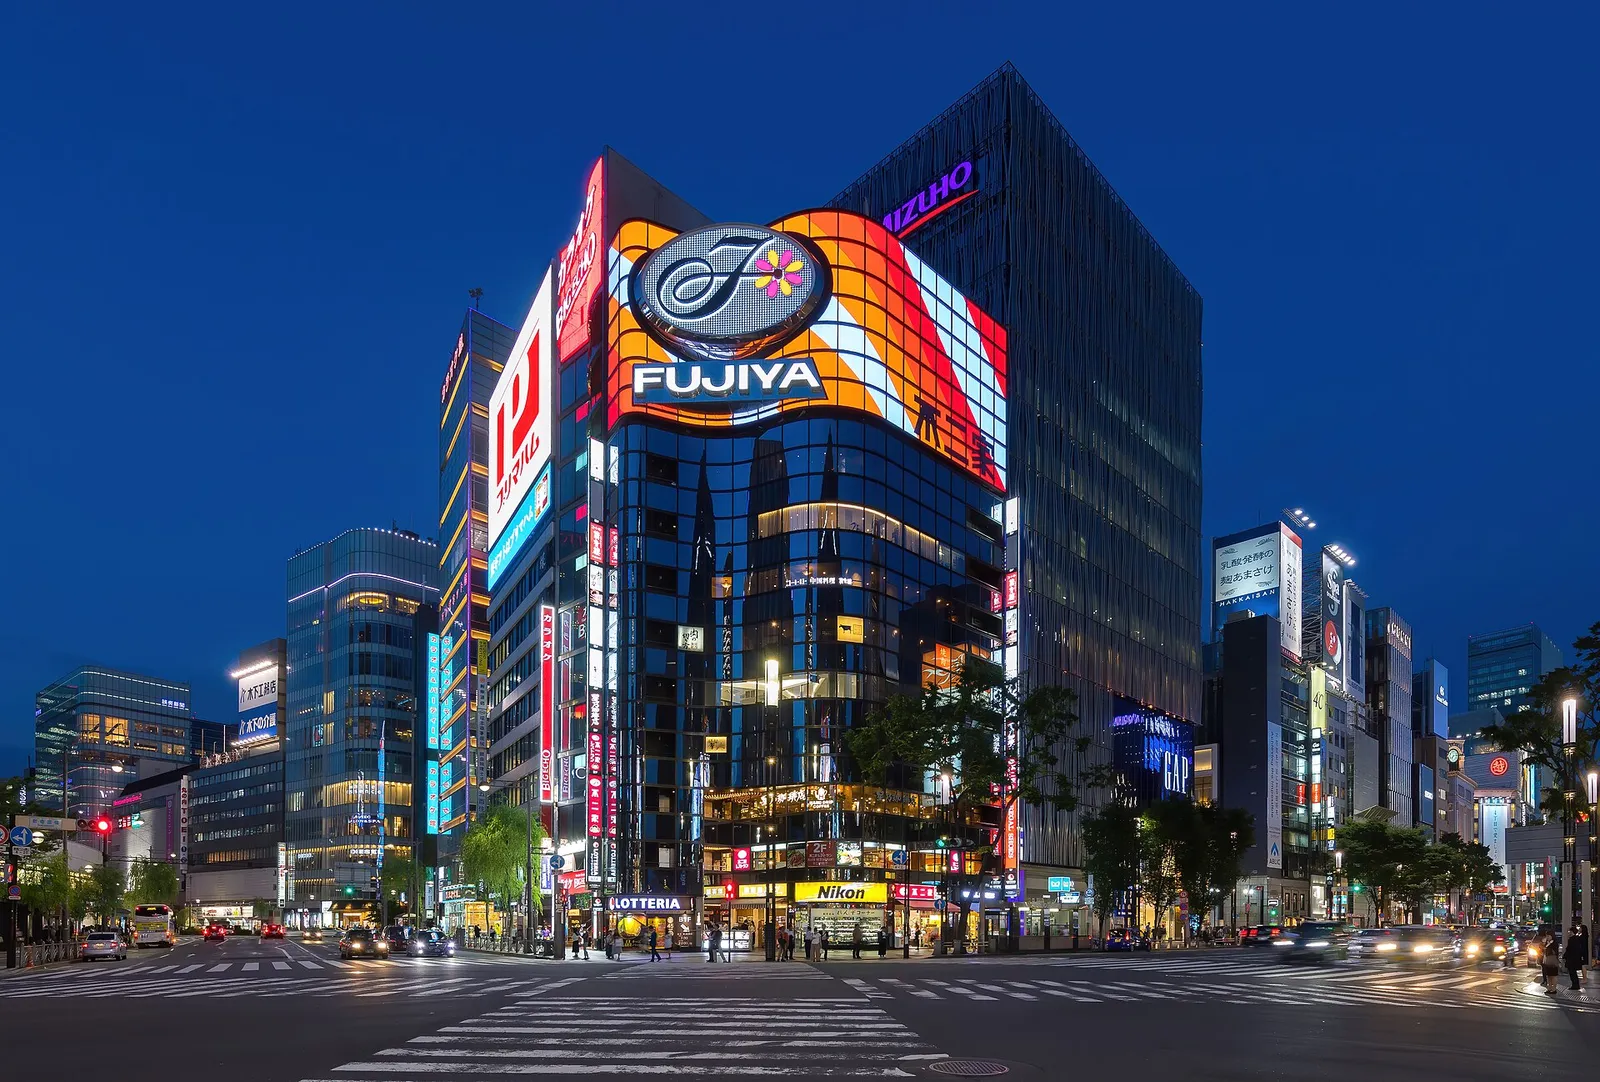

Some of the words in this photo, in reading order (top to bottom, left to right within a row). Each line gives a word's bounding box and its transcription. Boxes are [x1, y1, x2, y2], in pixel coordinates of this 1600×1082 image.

[634, 362, 821, 395] FUJIYA
[914, 394, 995, 481] 不二家
[497, 432, 540, 514] プリマハム
[1220, 549, 1274, 571] 乳酸発酵の
[1220, 564, 1274, 586] 麹あまさけ
[1219, 589, 1275, 607] HAKKAISAN
[543, 614, 552, 661] カラオケ
[1164, 750, 1188, 794] GAP
[591, 789, 599, 823] 不二家
[813, 842, 827, 854] 2F
[818, 885, 865, 899] Nikon
[911, 887, 933, 896] 不二家
[615, 897, 681, 909] LOTTERIA
